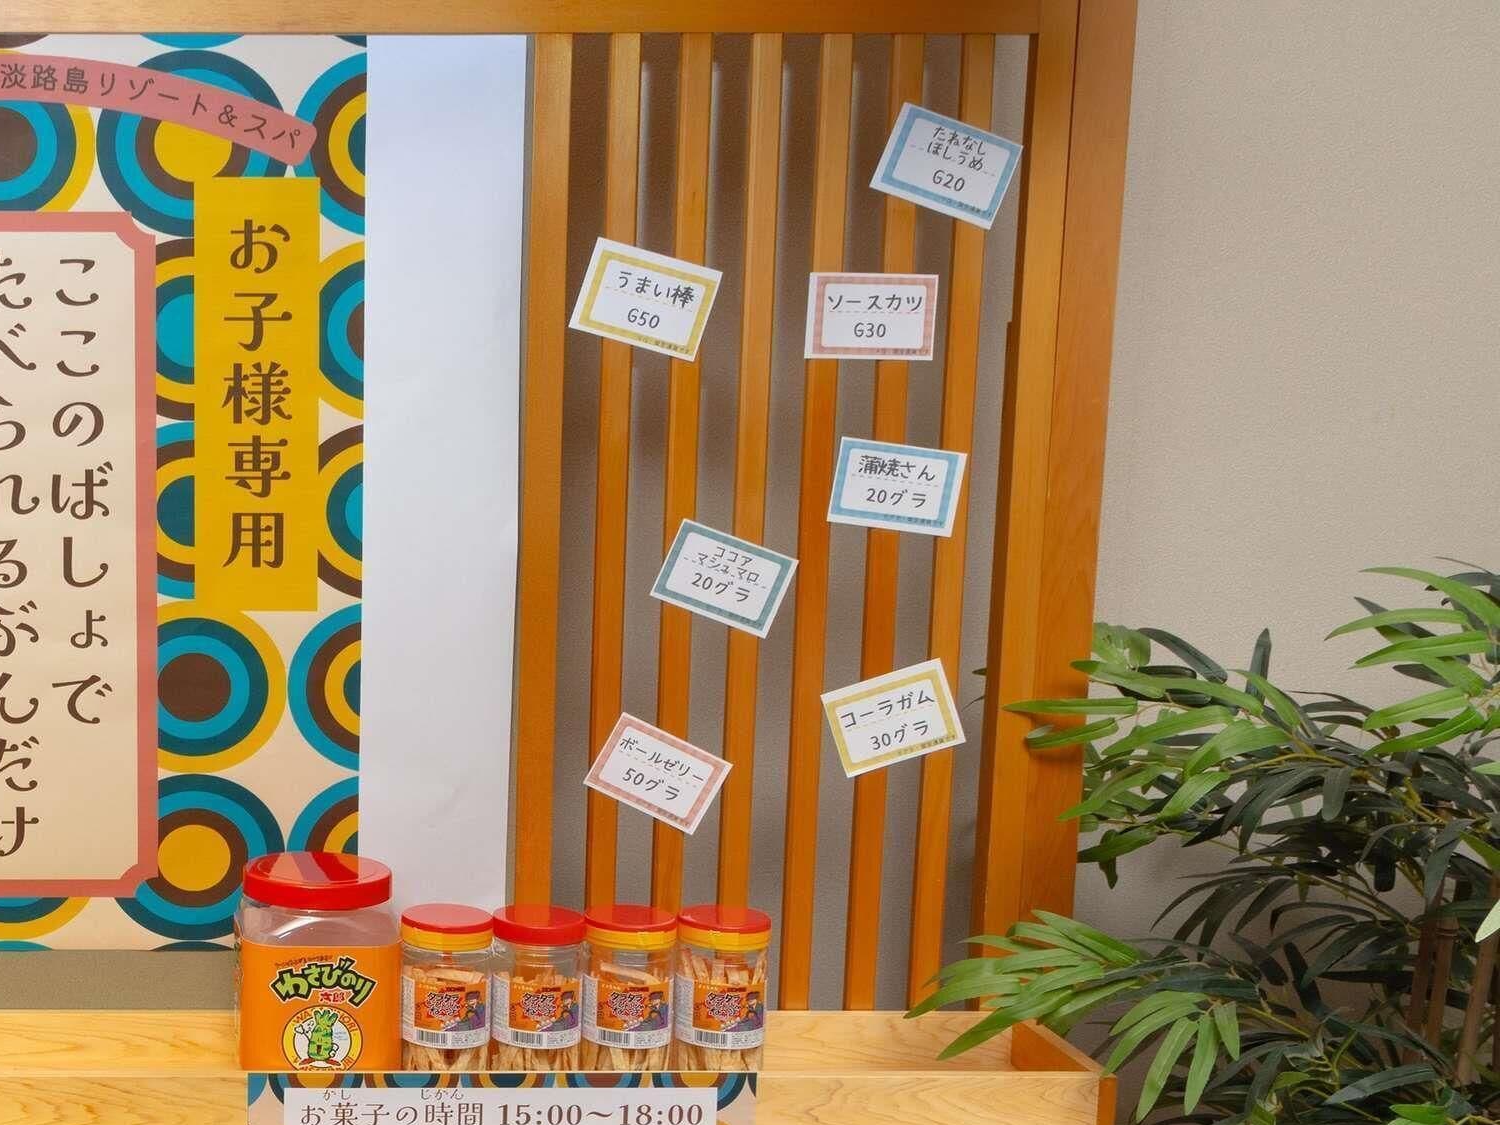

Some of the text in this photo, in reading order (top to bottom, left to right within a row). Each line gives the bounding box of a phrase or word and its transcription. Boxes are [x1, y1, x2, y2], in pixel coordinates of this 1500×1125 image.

[932, 126, 987, 155] たねなし
[927, 141, 985, 172] ほしうめ
[932, 169, 965, 193] G20
[617, 270, 694, 309] うまい棒
[828, 294, 924, 312] ソースカツ
[627, 308, 661, 330] G50
[854, 322, 886, 338] G30
[221, 218, 293, 569] お子様専用
[858, 454, 936, 482] 蒲焼さん
[52, 257, 114, 726] ここのばしょで
[866, 488, 927, 509] 20グラ
[696, 552, 760, 583] マシュマロ
[716, 546, 753, 565] ココア
[690, 571, 750, 603] 20グラ
[840, 690, 935, 730] コーラガム
[869, 721, 929, 750] 30グラ
[619, 735, 704, 782] ボールゼリー
[623, 767, 680, 801] 50グラ
[272, 956, 375, 1006] わさびのり
[323, 1089, 352, 1101] かし
[420, 1089, 465, 1101] じかん
